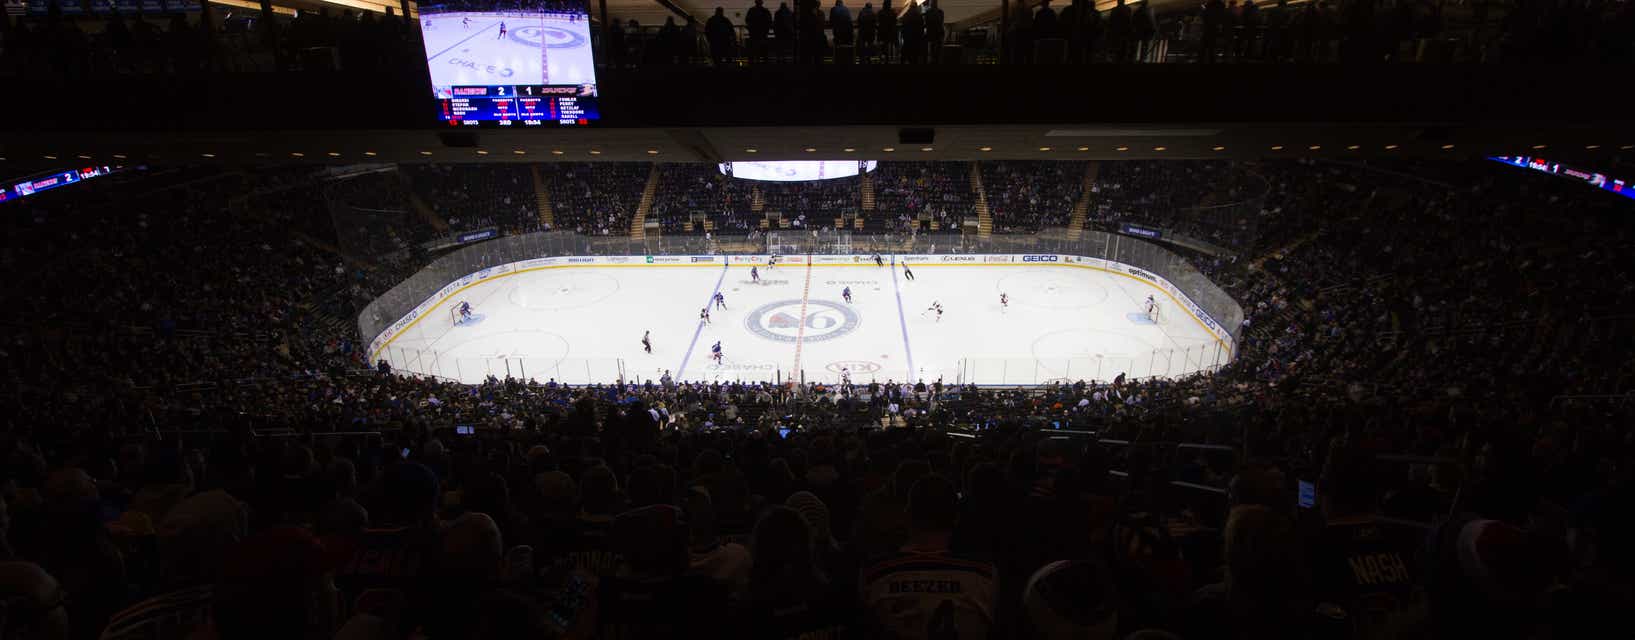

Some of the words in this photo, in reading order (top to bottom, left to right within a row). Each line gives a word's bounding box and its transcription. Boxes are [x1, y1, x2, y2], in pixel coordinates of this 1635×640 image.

[498, 87, 505, 96] 2
[525, 86, 532, 96] 1
[64, 173, 73, 182] 2
[1128, 267, 1157, 282] optimum
[1347, 551, 1409, 585] NASH
